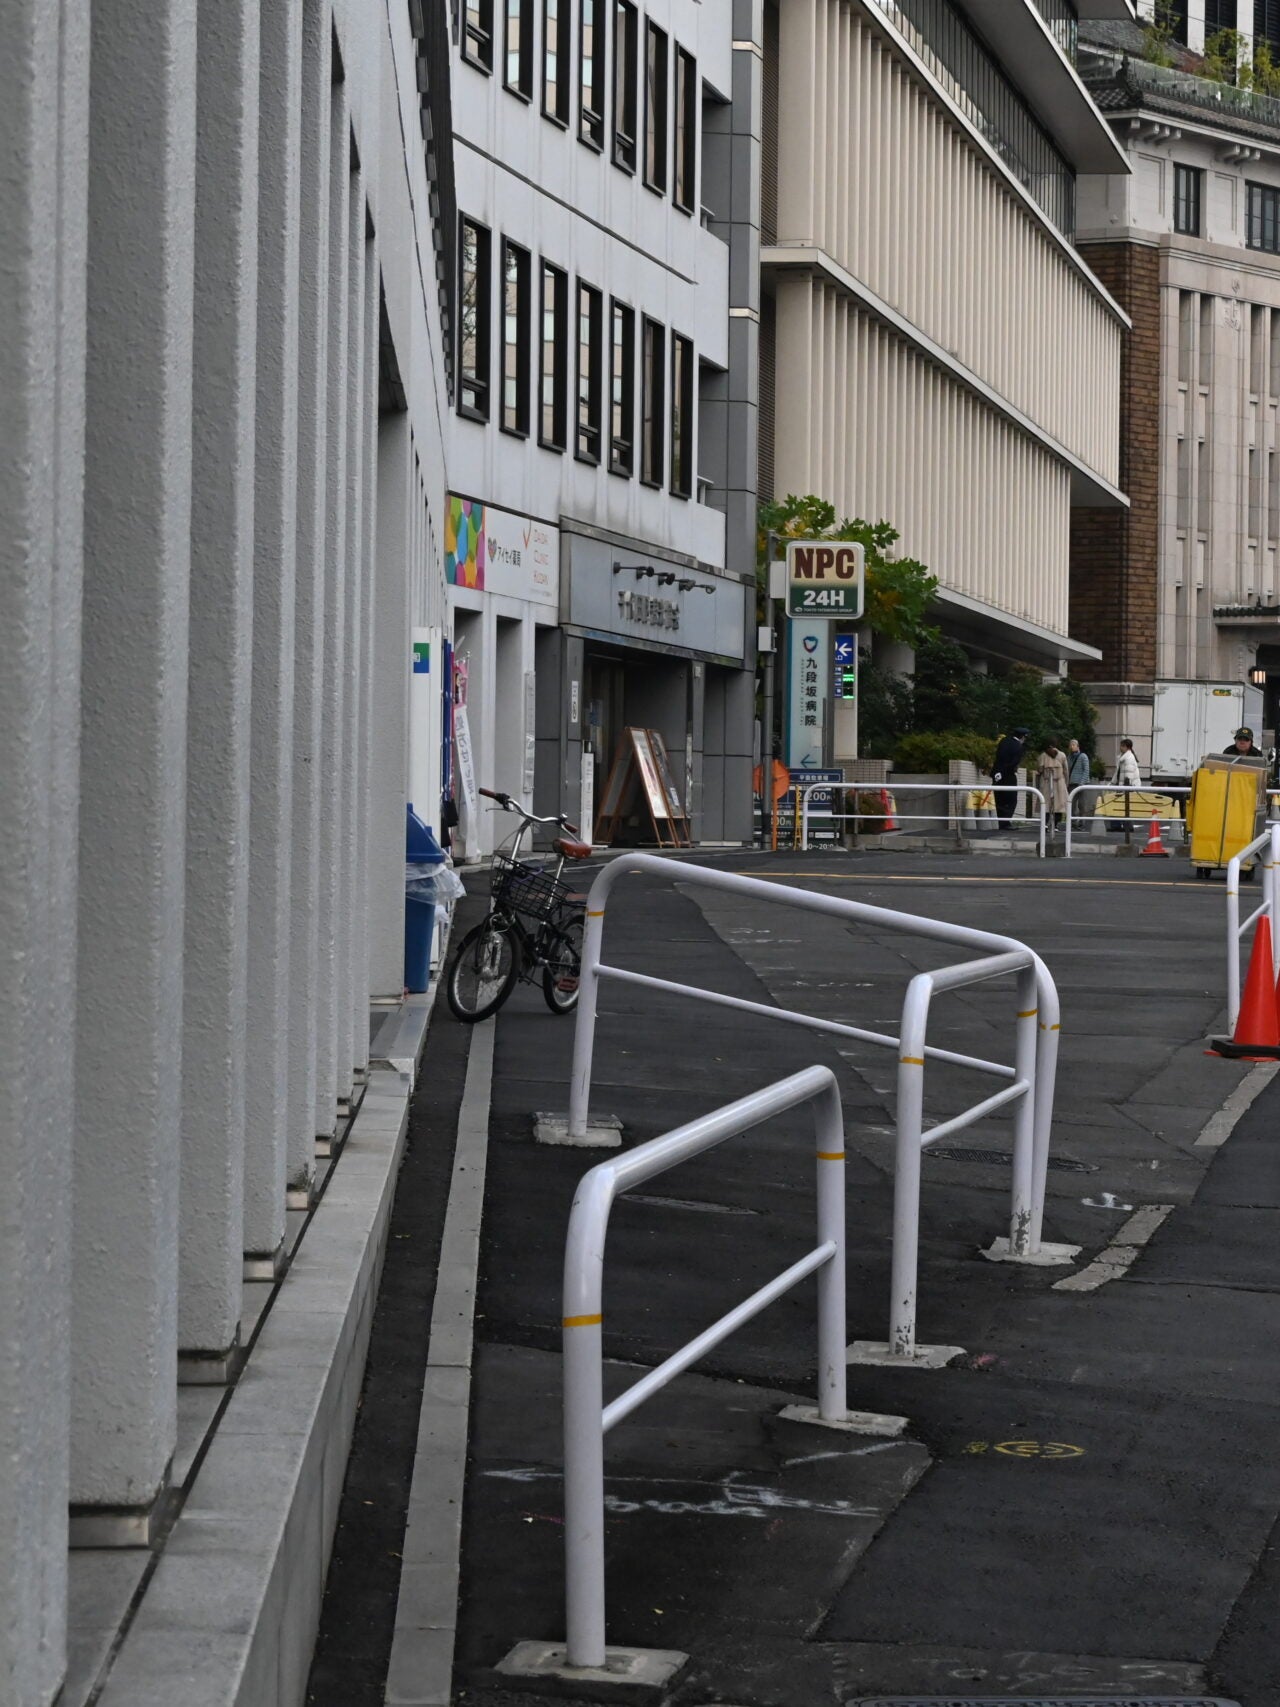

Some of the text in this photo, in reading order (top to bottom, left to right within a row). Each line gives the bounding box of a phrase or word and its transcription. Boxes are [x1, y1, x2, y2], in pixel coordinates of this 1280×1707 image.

[794, 548, 855, 579] NPC
[803, 590, 845, 606] 24H
[804, 657, 817, 726] 九段坂病院
